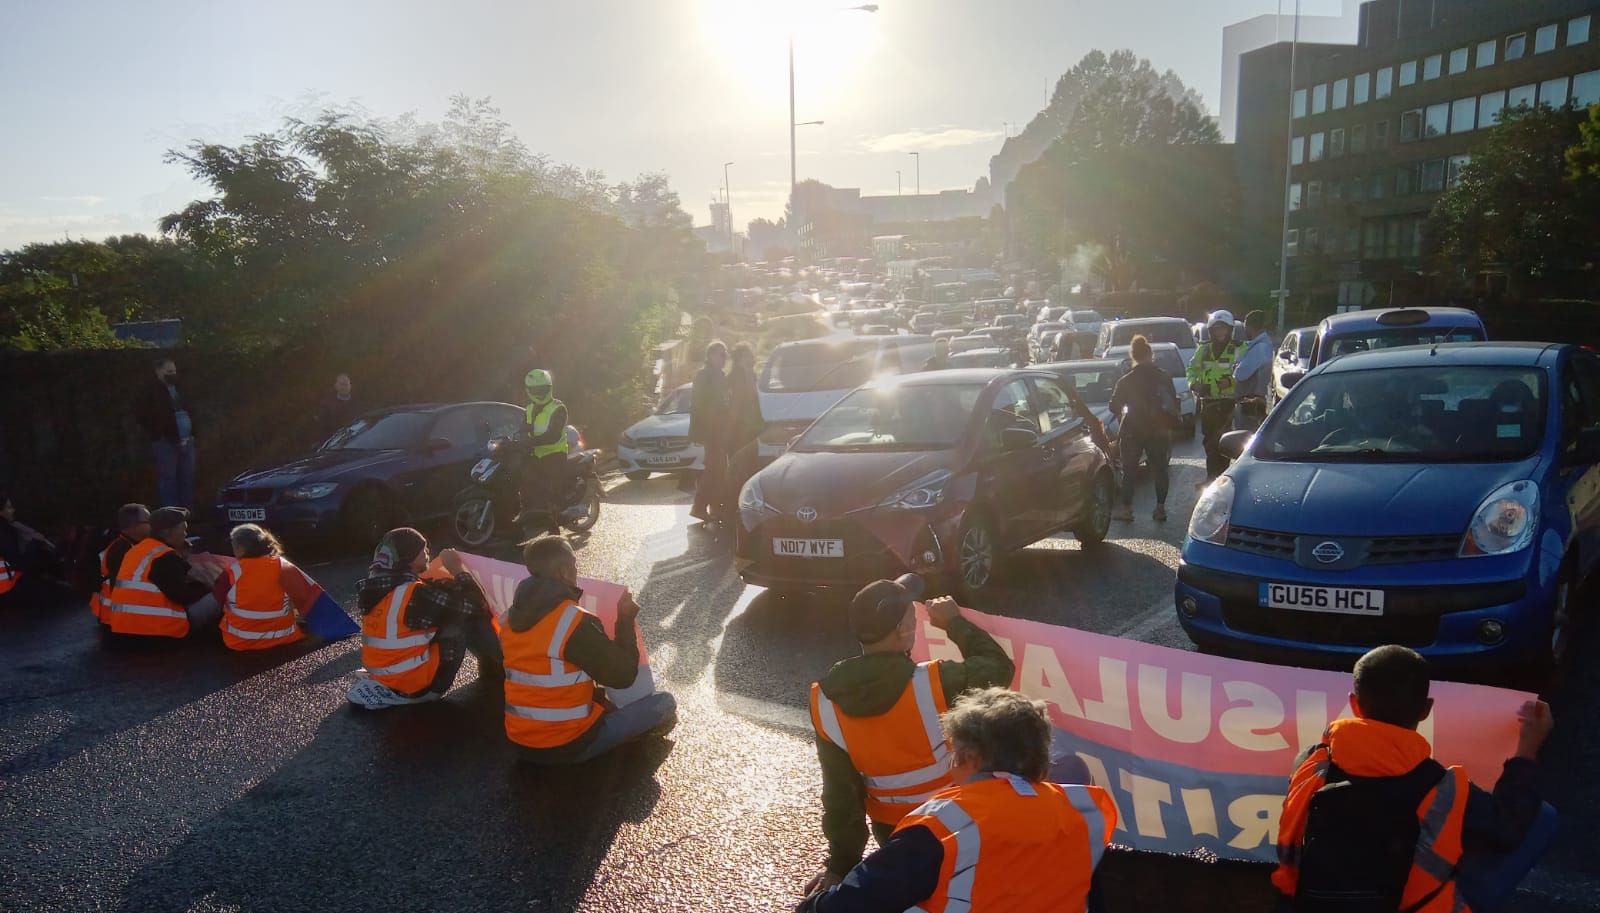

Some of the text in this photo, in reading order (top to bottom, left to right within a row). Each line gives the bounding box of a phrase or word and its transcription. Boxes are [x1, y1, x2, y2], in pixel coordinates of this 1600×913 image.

[780, 540, 835, 555] ND17 WYF
[1272, 585, 1380, 611] GU56 HCL
